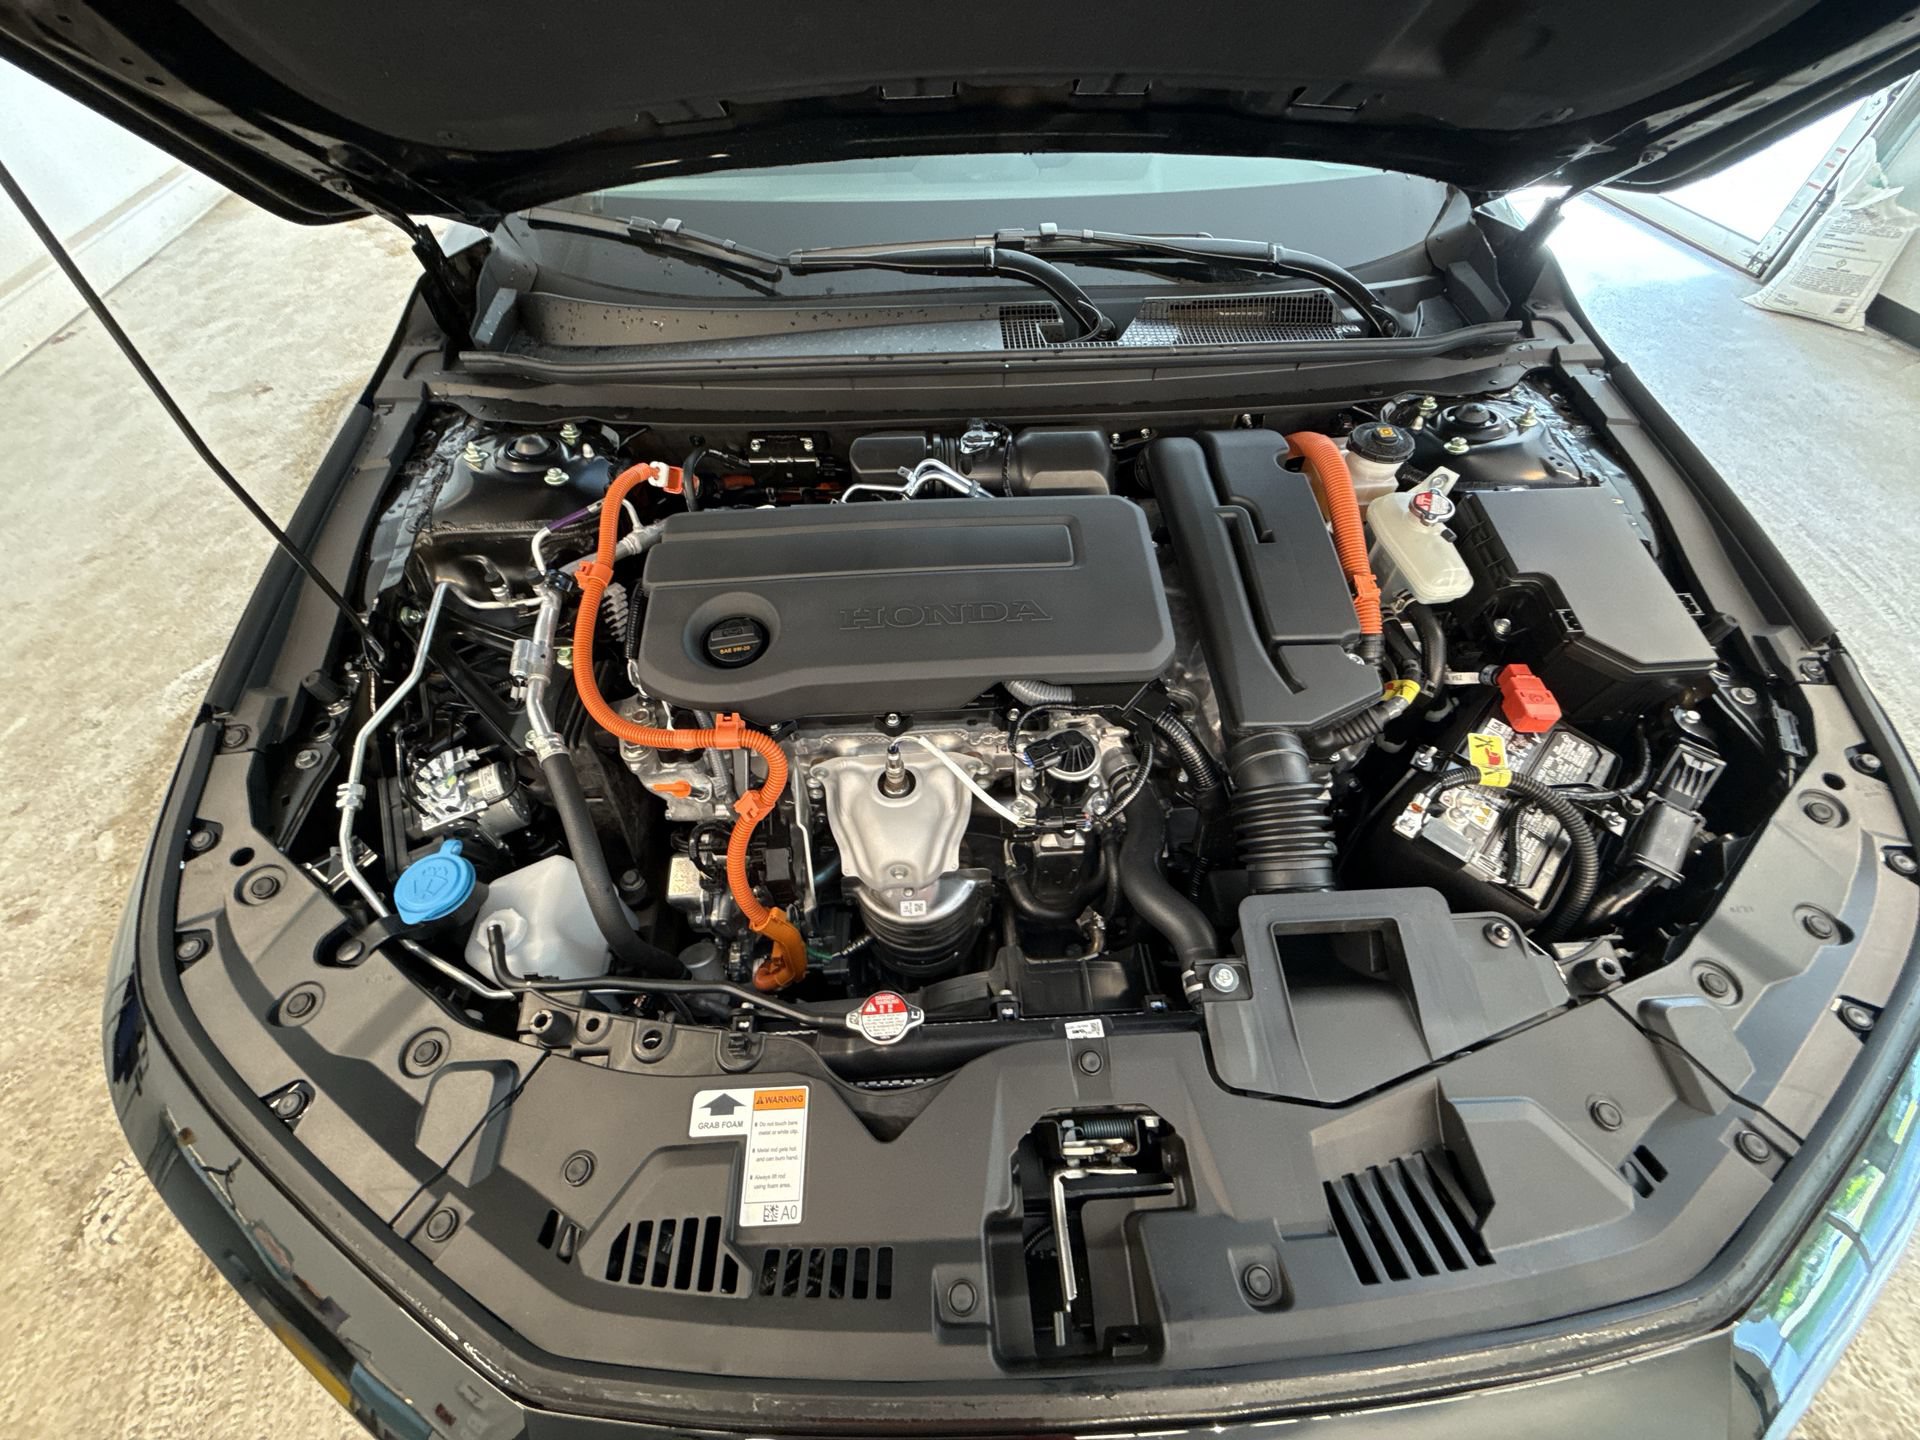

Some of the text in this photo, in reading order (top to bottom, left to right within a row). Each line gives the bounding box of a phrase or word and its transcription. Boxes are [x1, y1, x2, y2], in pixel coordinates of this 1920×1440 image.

[839, 599, 1053, 630] HONDA
[764, 1095, 804, 1104] WARNING
[698, 1121, 744, 1130] GRAB FOAM
